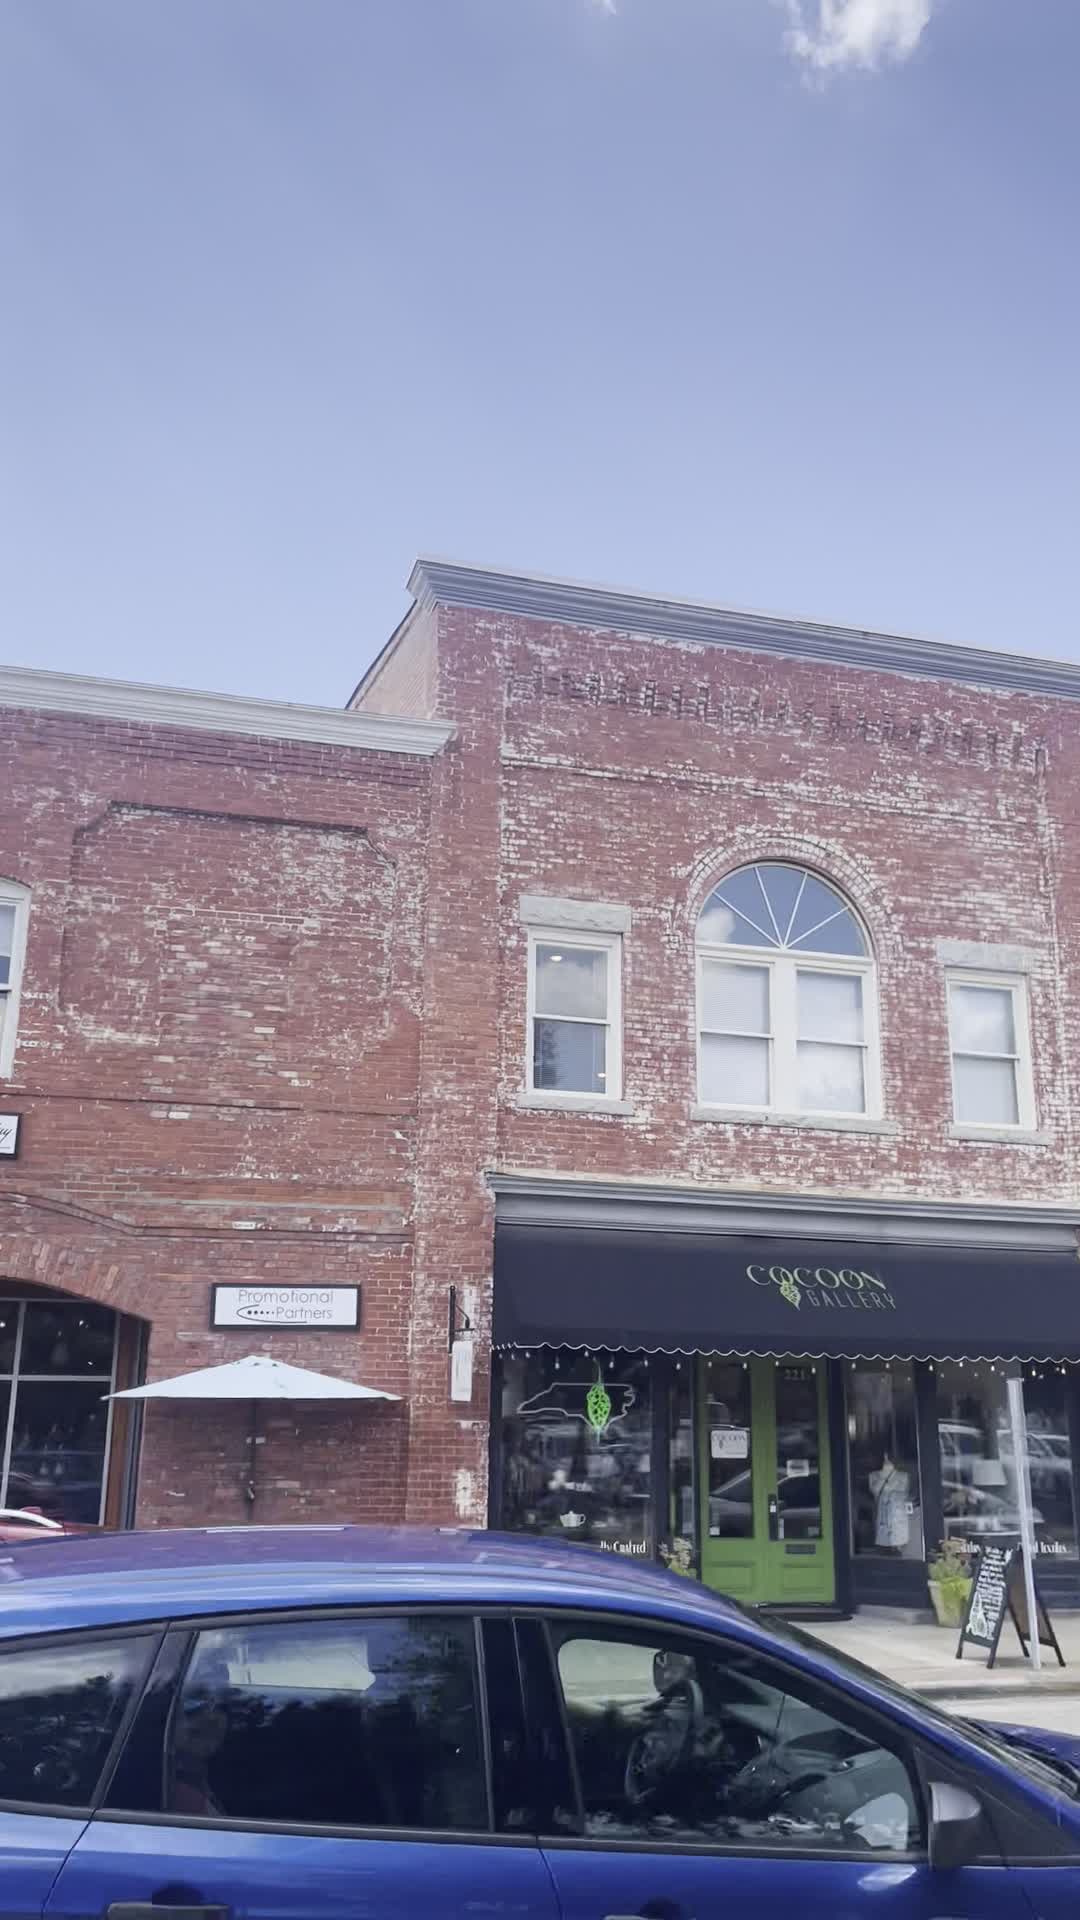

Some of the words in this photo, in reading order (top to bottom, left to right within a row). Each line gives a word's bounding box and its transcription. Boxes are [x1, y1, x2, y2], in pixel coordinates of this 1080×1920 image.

[746, 1264, 887, 1290] COCOON
[238, 1289, 334, 1304] Promotional
[805, 1289, 897, 1310] GALLERY
[276, 1306, 333, 1319] Partners
